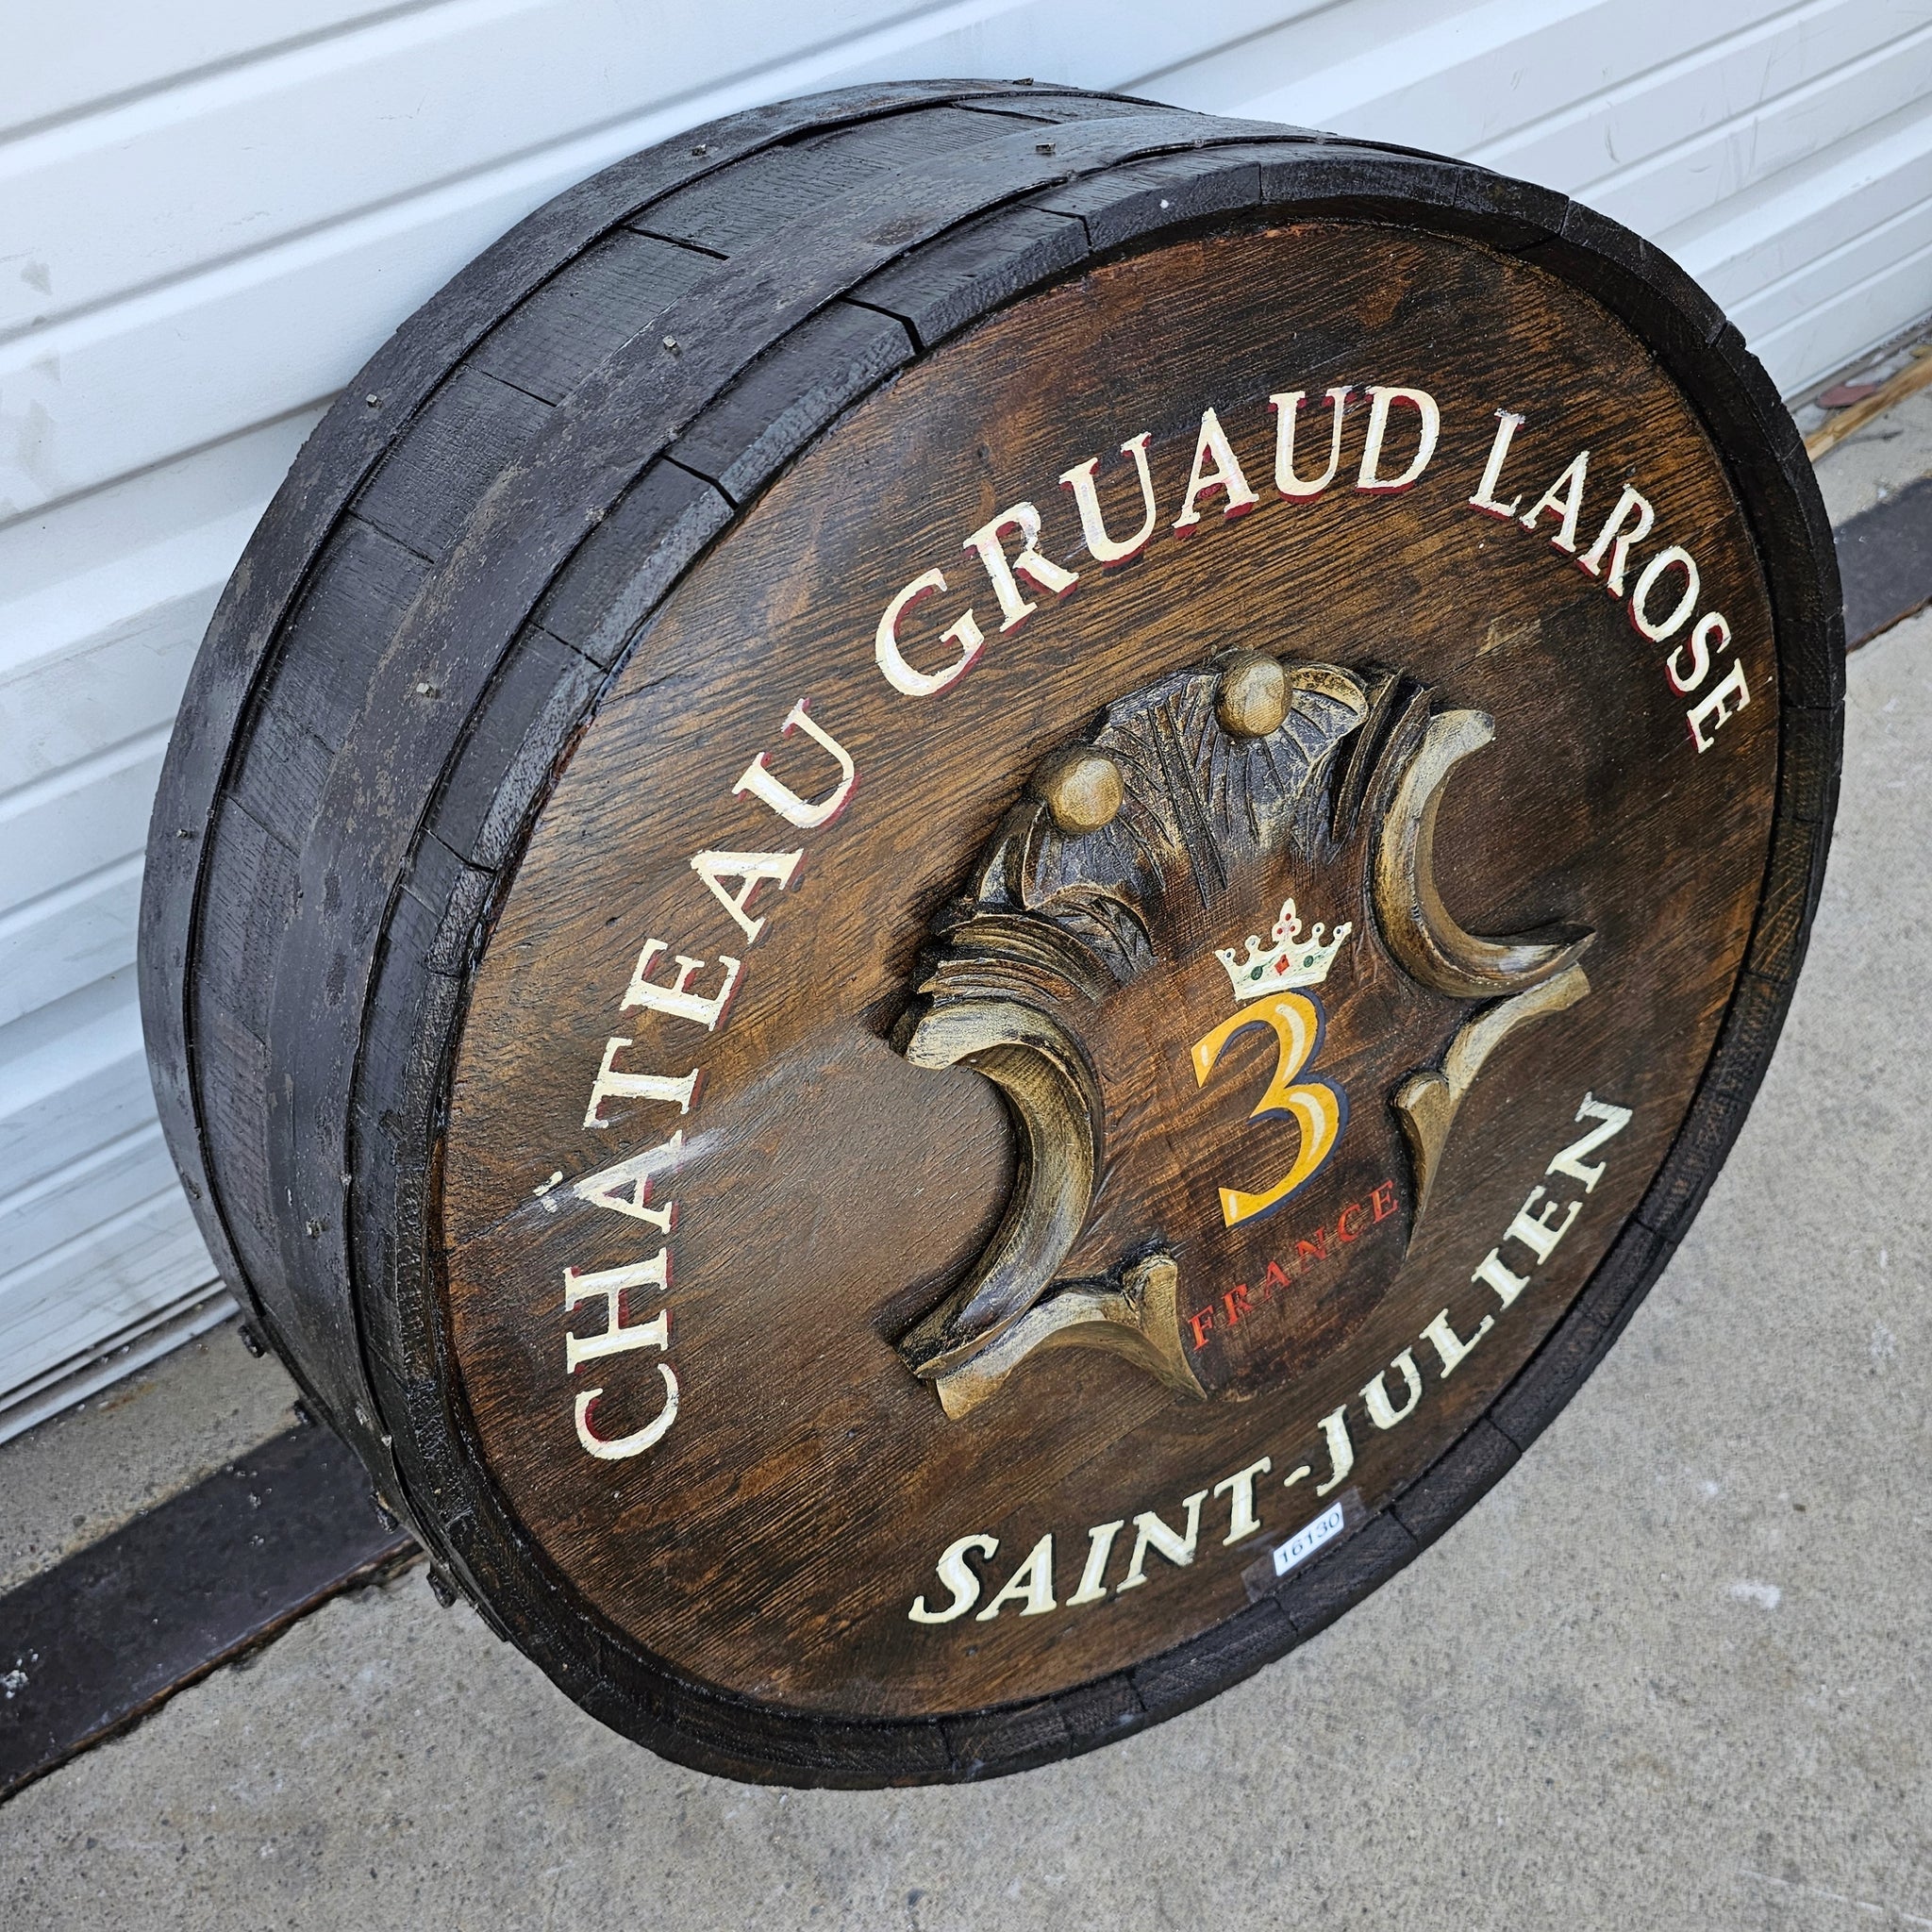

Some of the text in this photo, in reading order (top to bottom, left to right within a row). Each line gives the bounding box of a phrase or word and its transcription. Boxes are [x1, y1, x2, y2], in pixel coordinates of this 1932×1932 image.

[874, 384, 1441, 696] GRUAUD
[1468, 408, 1751, 754] LAROSE
[1191, 987, 1350, 1227] 3
[908, 1091, 1633, 1624] SAINT-JULIEN
[1187, 1179, 1399, 1351] FRANCE
[1278, 1511, 1341, 1563] 16130
